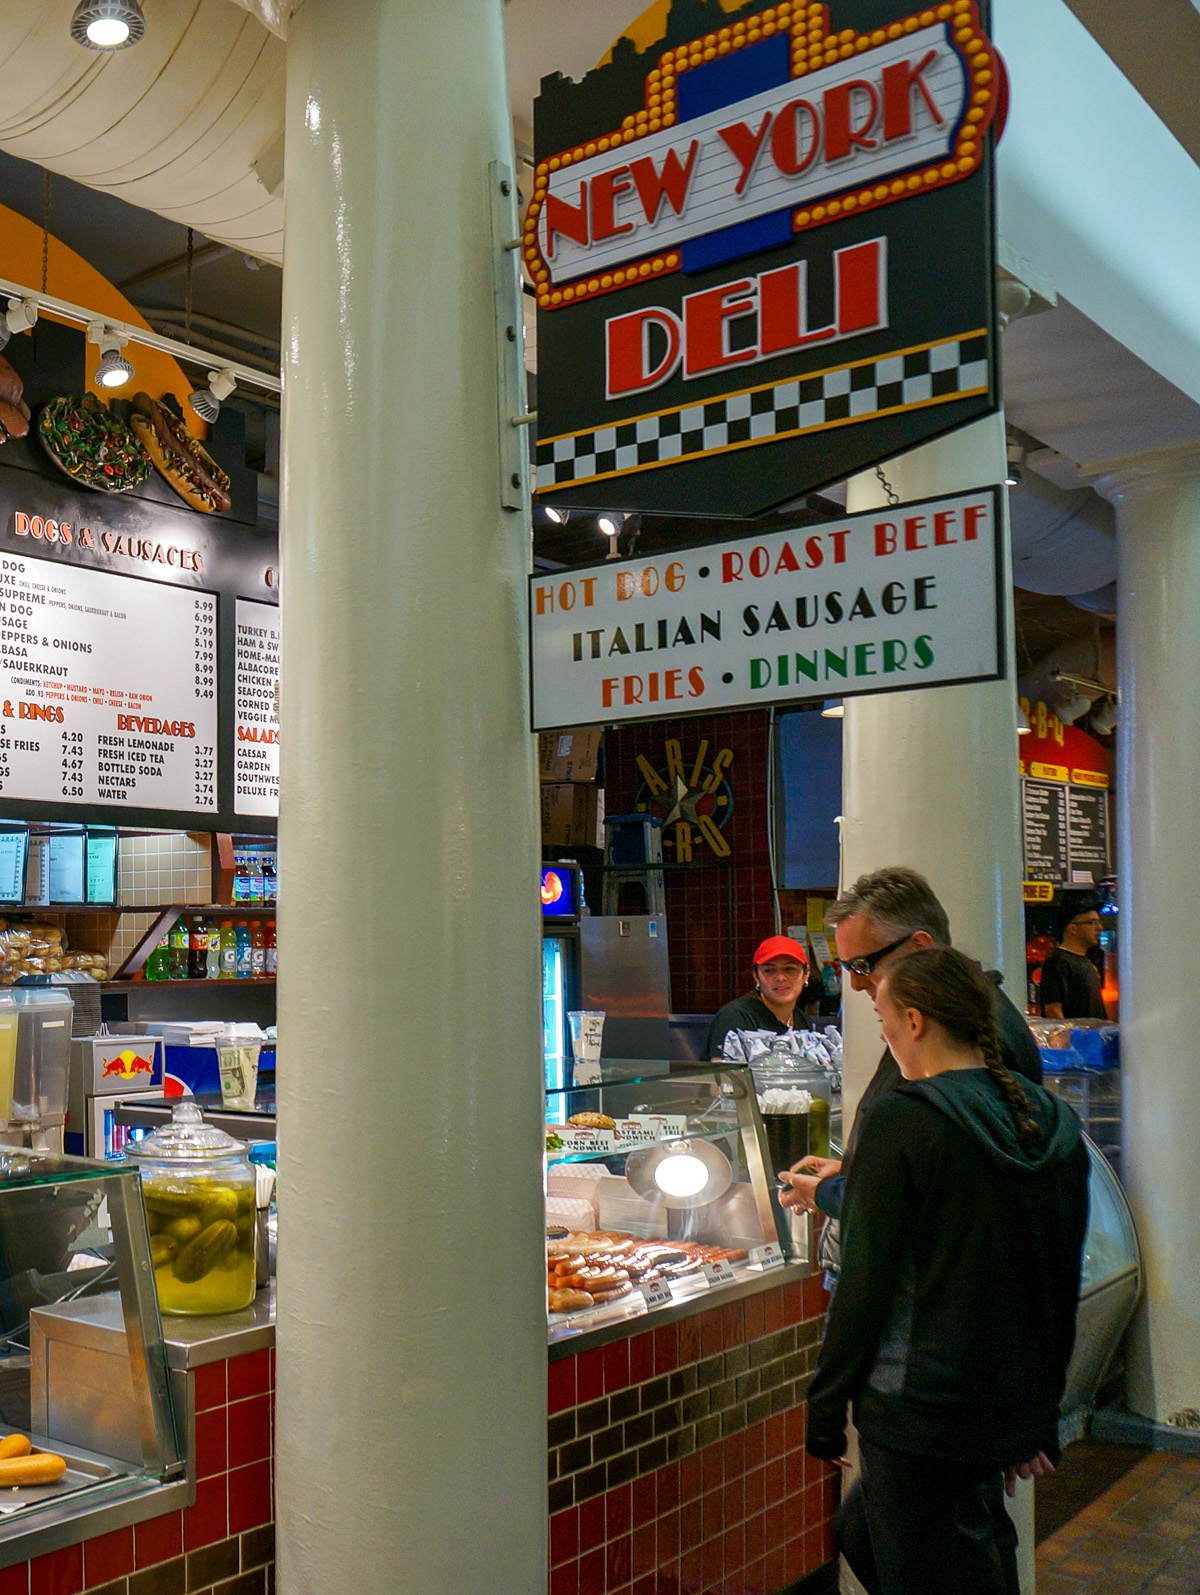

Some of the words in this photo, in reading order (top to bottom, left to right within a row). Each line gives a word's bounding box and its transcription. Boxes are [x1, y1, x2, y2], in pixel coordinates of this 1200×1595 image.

[544, 138, 700, 262] NEW
[717, 48, 948, 199] YORK
[605, 235, 890, 401] DELI
[15, 512, 73, 545] DOGS
[79, 527, 95, 549] &
[722, 530, 851, 583] ROAST
[874, 505, 987, 557] BEEF
[2, 560, 25, 573] DOG
[536, 577, 598, 615] HOT
[616, 562, 686, 602] DOG
[0, 587, 45, 605] SUPREME
[195, 600, 213, 611] 5.99
[573, 610, 721, 662] ITALIAN
[743, 576, 937, 637] SAUSAGE
[195, 625, 213, 636] 7.99
[237, 624, 268, 637] TURKEY
[237, 661, 278, 675] ALBACORE
[750, 635, 934, 689] DINNERS
[237, 674, 271, 686] CHICKEN
[602, 666, 705, 708] FRIES
[237, 686, 275, 699] SEAFOOD
[237, 698, 269, 710] CORNED
[2, 700, 14, 717] &
[19, 701, 65, 724] RINGS
[237, 711, 267, 723] VEGGIE
[117, 713, 196, 739] BEVERAGES
[98, 735, 124, 747] FRESH
[128, 738, 174, 752] LEMONADE
[237, 748, 266, 759] CAESAR
[98, 762, 136, 774] BOTTLED
[139, 765, 162, 777] SODA
[237, 760, 270, 771] GARDEN
[98, 775, 136, 787] NECTARS
[98, 788, 127, 800] WATER
